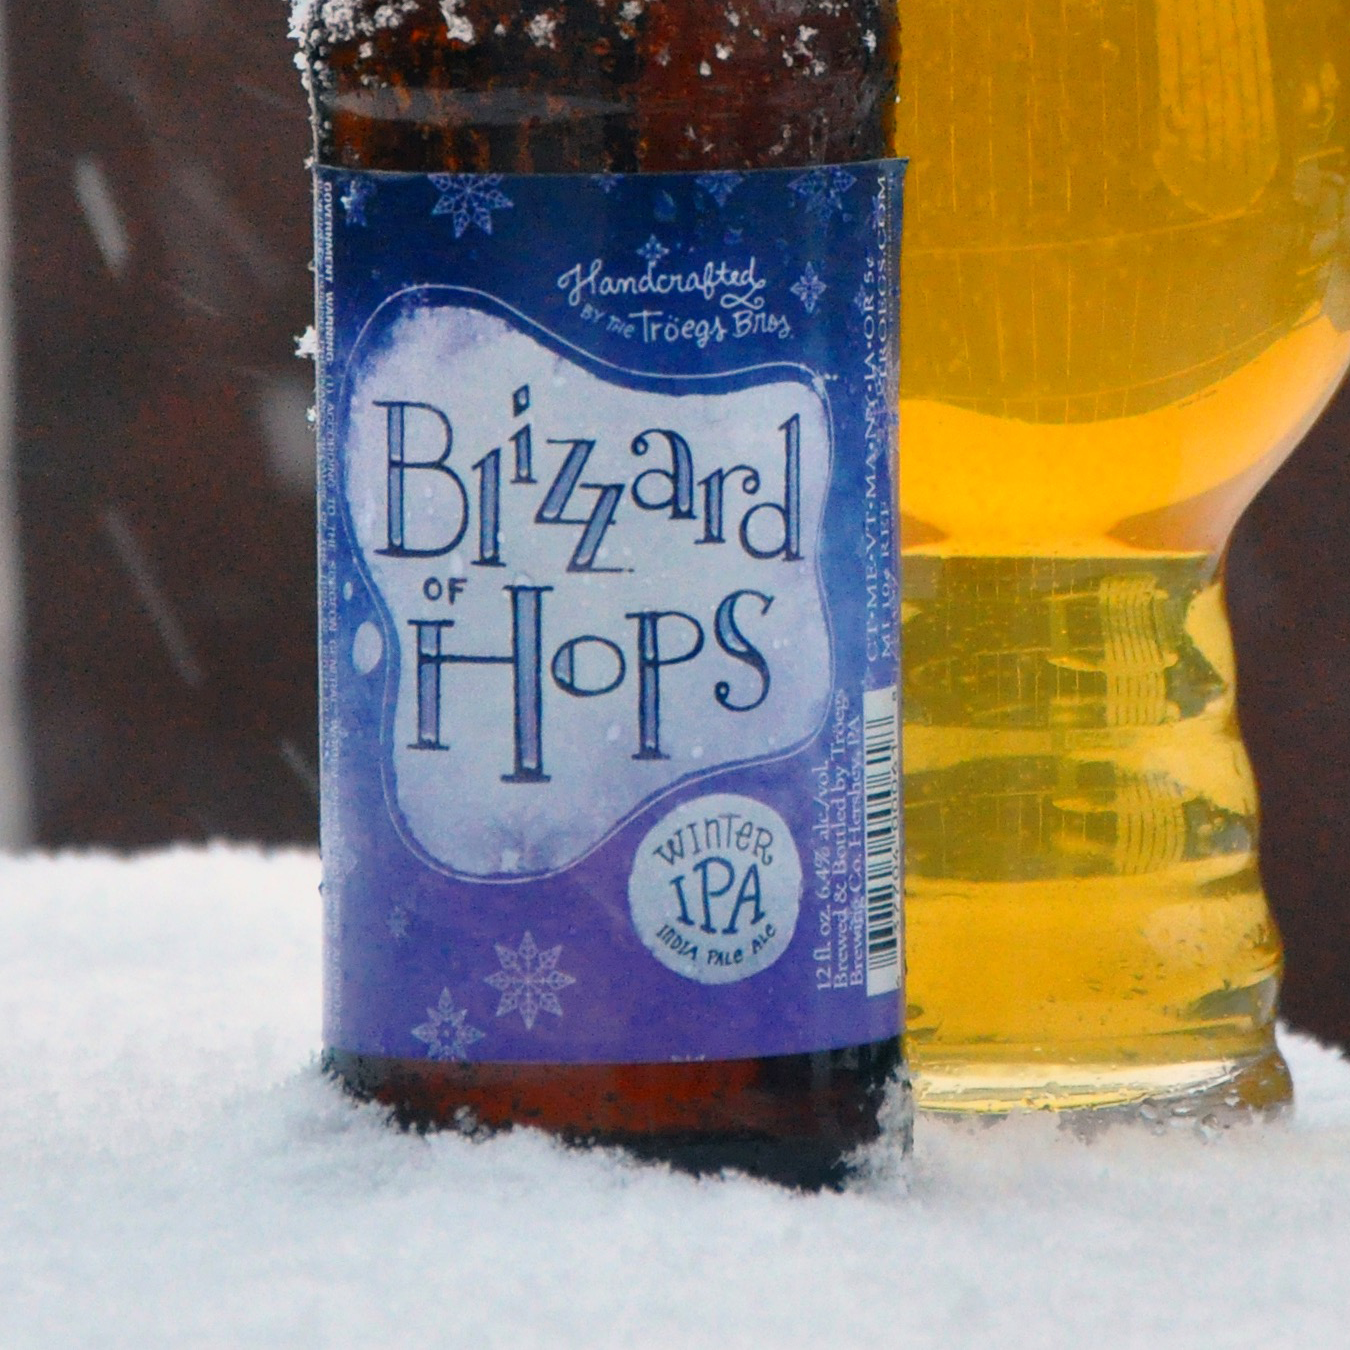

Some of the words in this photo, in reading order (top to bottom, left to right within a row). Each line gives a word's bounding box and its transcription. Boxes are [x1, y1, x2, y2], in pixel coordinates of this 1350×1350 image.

[557, 255, 767, 310] Handcrafted
[580, 302, 606, 321] BY
[372, 384, 805, 573] Blizzard
[422, 576, 468, 605] OF
[847, 715, 861, 745] PA
[830, 765, 850, 792] by
[831, 798, 847, 875] Bottled
[669, 856, 766, 935] IPA
[833, 881, 847, 903] &
[832, 908, 849, 989] Brewed
[849, 895, 865, 986] Brewing
[816, 966, 832, 990] 12
